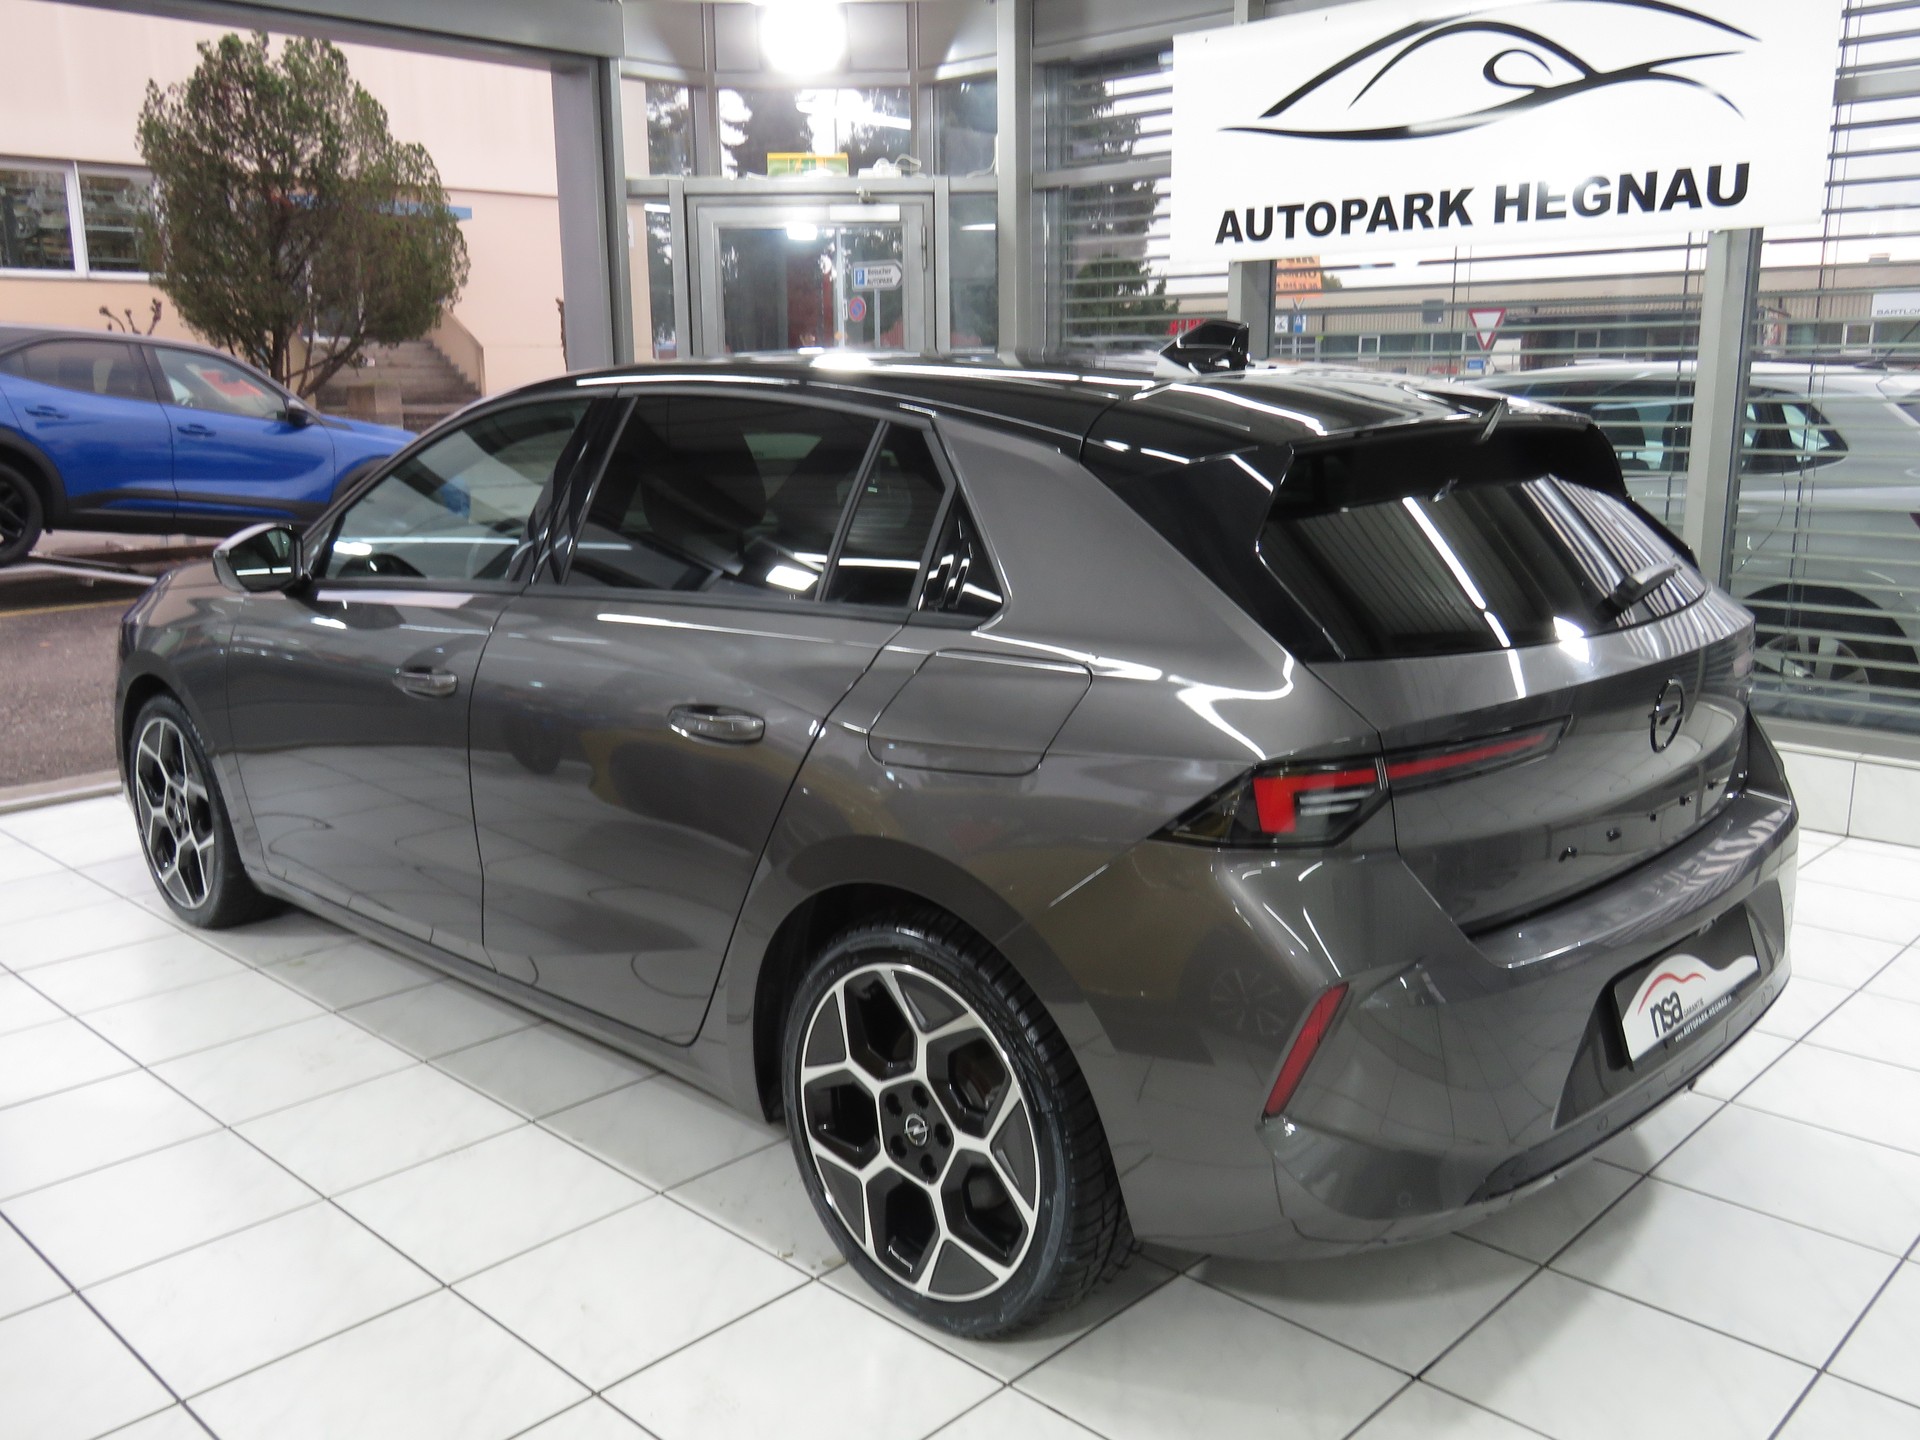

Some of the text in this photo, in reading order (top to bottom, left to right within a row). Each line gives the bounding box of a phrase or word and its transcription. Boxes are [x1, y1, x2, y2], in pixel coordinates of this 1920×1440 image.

[1214, 161, 1752, 245] AUTOPARK HEGNAU
[1649, 991, 1684, 1039] nsa
